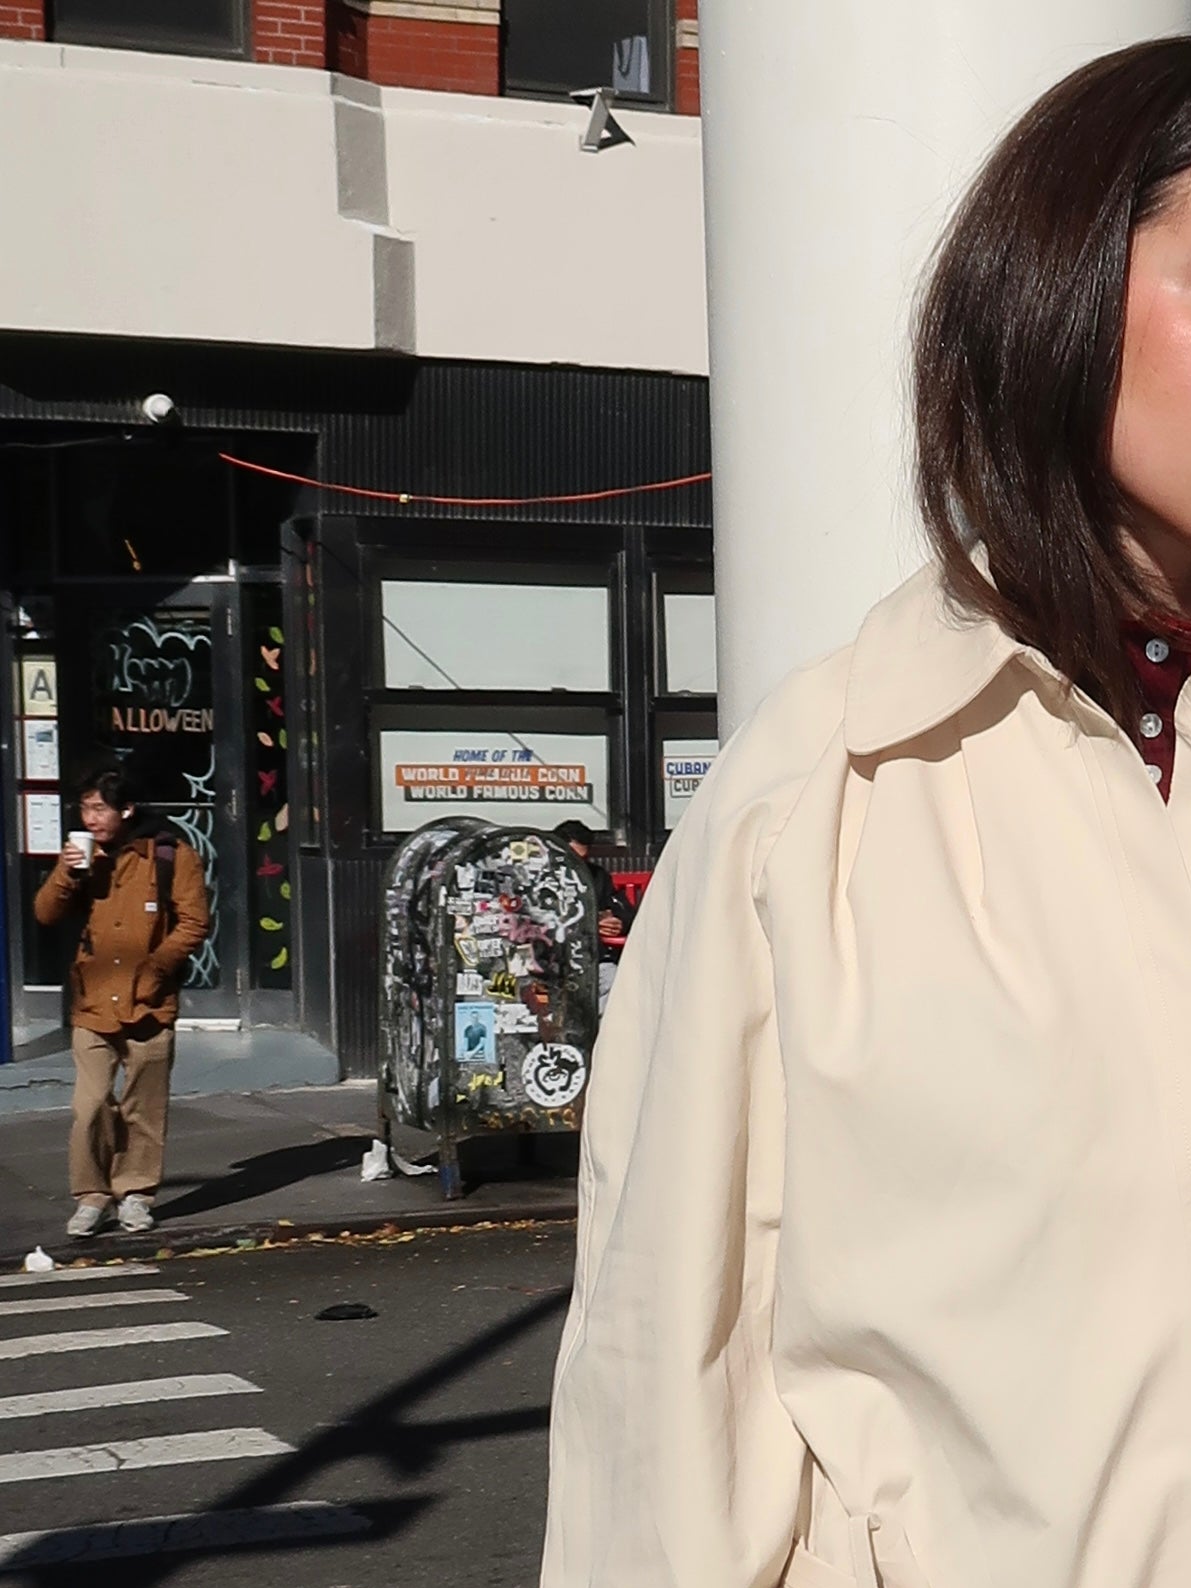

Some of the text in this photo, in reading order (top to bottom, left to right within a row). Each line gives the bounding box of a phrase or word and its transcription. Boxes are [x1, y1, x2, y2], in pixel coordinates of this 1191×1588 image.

[30, 669, 53, 700] A
[111, 706, 213, 732] ALLOWEEN
[452, 749, 534, 762] HOME OF THE
[401, 768, 459, 782] WORLD
[538, 768, 580, 782] CORN
[410, 785, 588, 800] WORLD FAMOUS CORN
